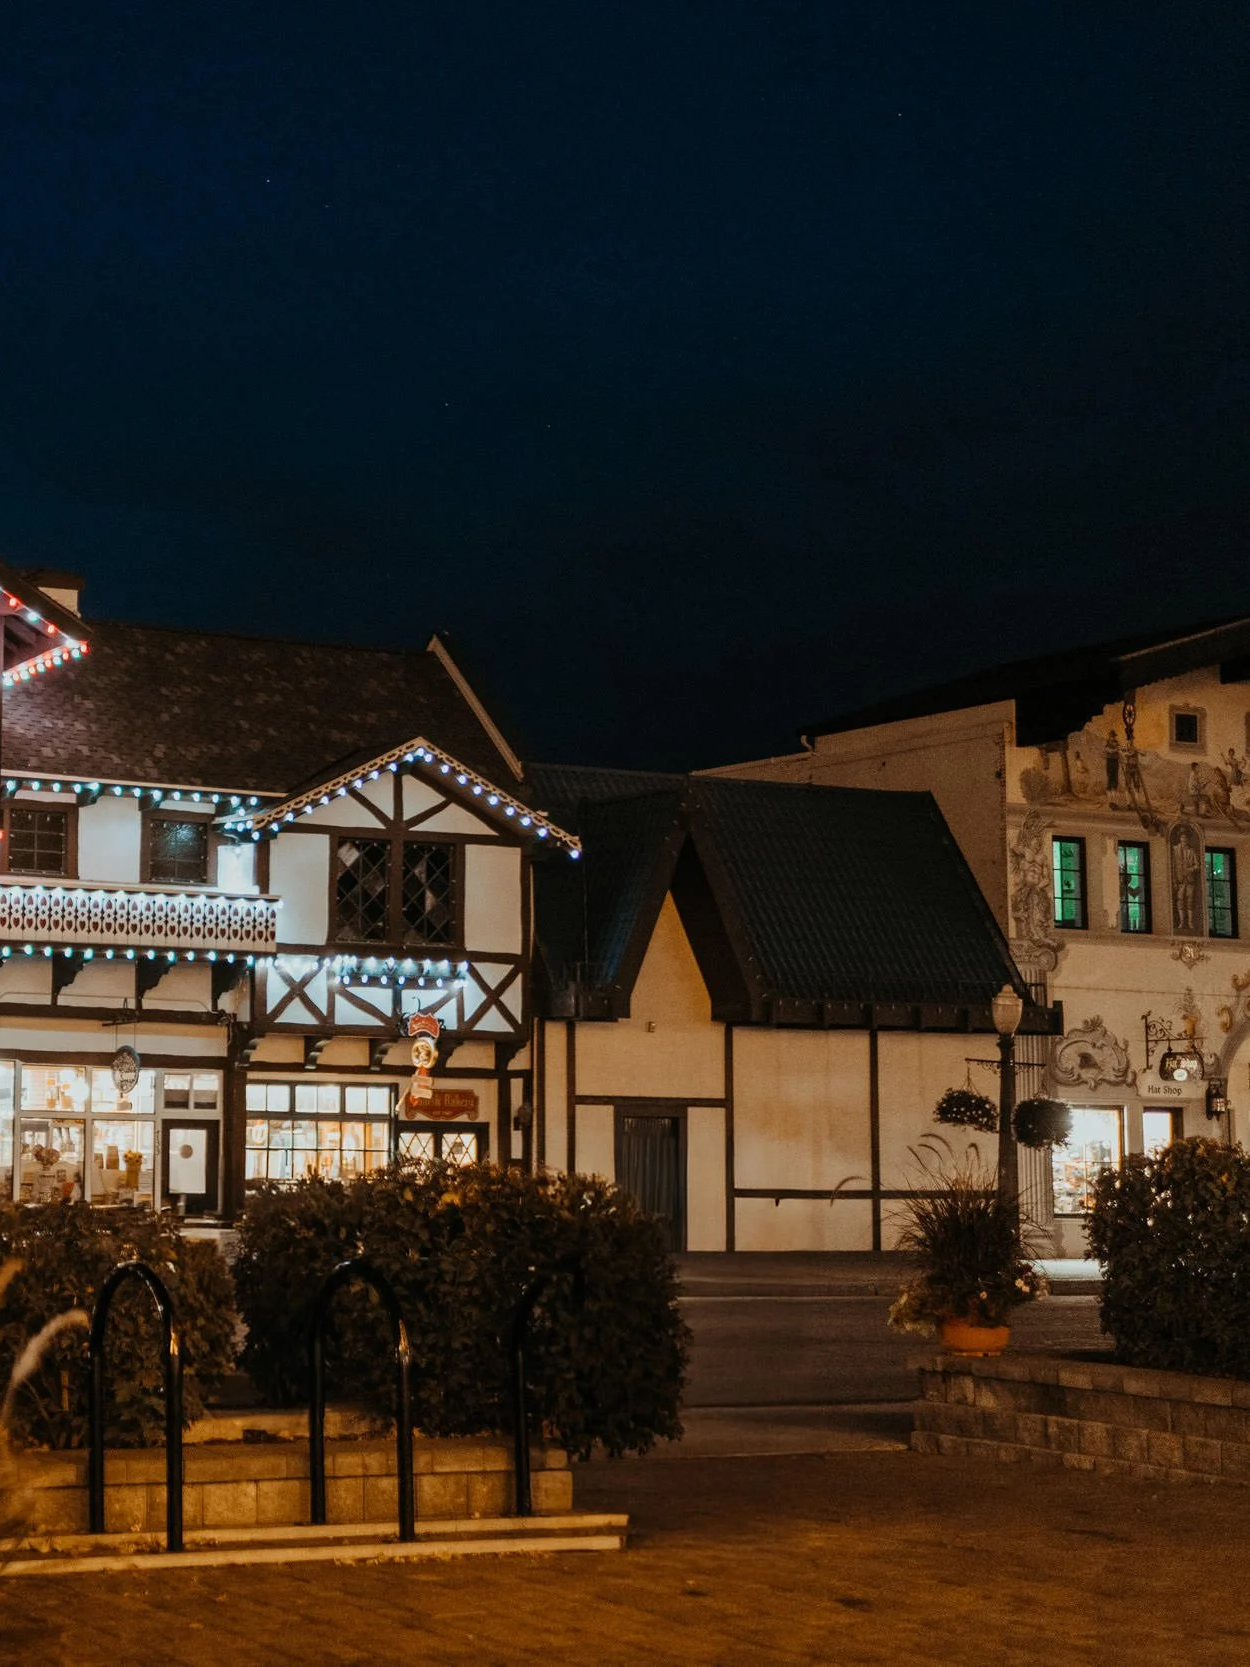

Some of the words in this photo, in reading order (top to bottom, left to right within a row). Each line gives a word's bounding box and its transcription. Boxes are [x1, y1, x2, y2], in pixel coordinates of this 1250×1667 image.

[1148, 1085, 1161, 1094] Hat
[1163, 1086, 1182, 1096] Shop
[444, 1093, 475, 1108] Bakery
